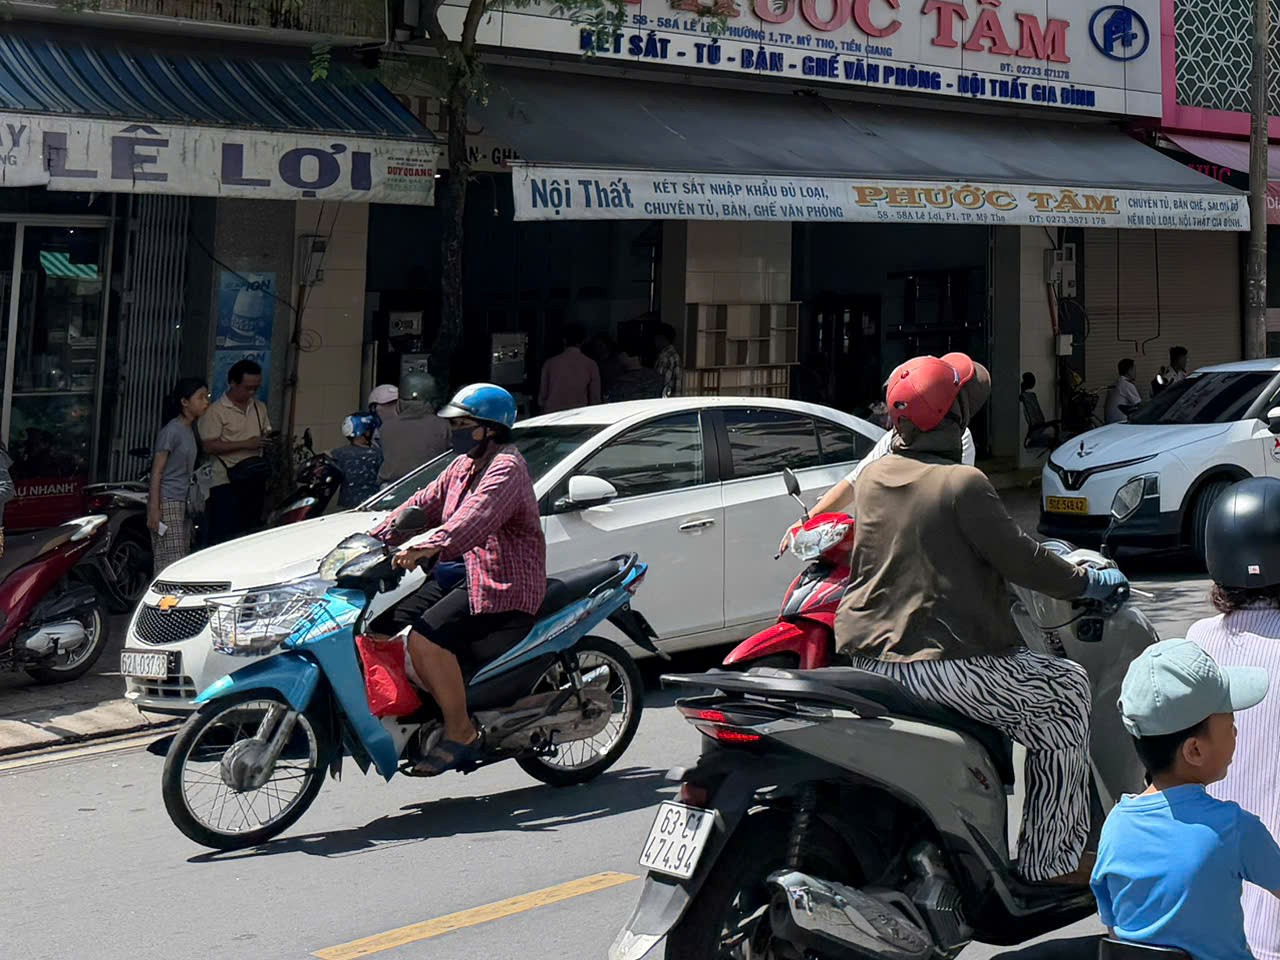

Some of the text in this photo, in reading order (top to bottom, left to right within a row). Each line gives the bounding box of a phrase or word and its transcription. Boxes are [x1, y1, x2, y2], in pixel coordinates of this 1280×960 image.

[632, 14, 648, 26] 58
[865, 45, 893, 57] GIANG
[628, 30, 671, 59] SẮT
[741, 46, 784, 72] BÀN
[802, 54, 840, 78] GHẾ
[844, 58, 880, 83] VĂN
[883, 65, 941, 90] PHÒNG
[958, 73, 986, 98] NỘI
[989, 76, 1029, 101] THẤT
[1031, 84, 1058, 104] GIA
[1061, 83, 1095, 107] ĐÌNH
[43, 125, 372, 197] LÊ LỢI
[530, 177, 634, 216] Nội Thất
[653, 177, 829, 200] KÉT SẮT NHẬP KHẨU ĐỦ LOẠI,
[852, 184, 1121, 215] PHƯỚC TÂM
[1127, 196, 1158, 209] CHUYÊN
[644, 199, 695, 215] CHUYÊN
[698, 199, 719, 218] TỦ,
[753, 201, 777, 217] GHẾ
[780, 202, 804, 218] VĂN
[807, 202, 844, 218] PHÒNG
[29, 482, 75, 496] NHANH
[644, 836, 697, 873] 474.94
